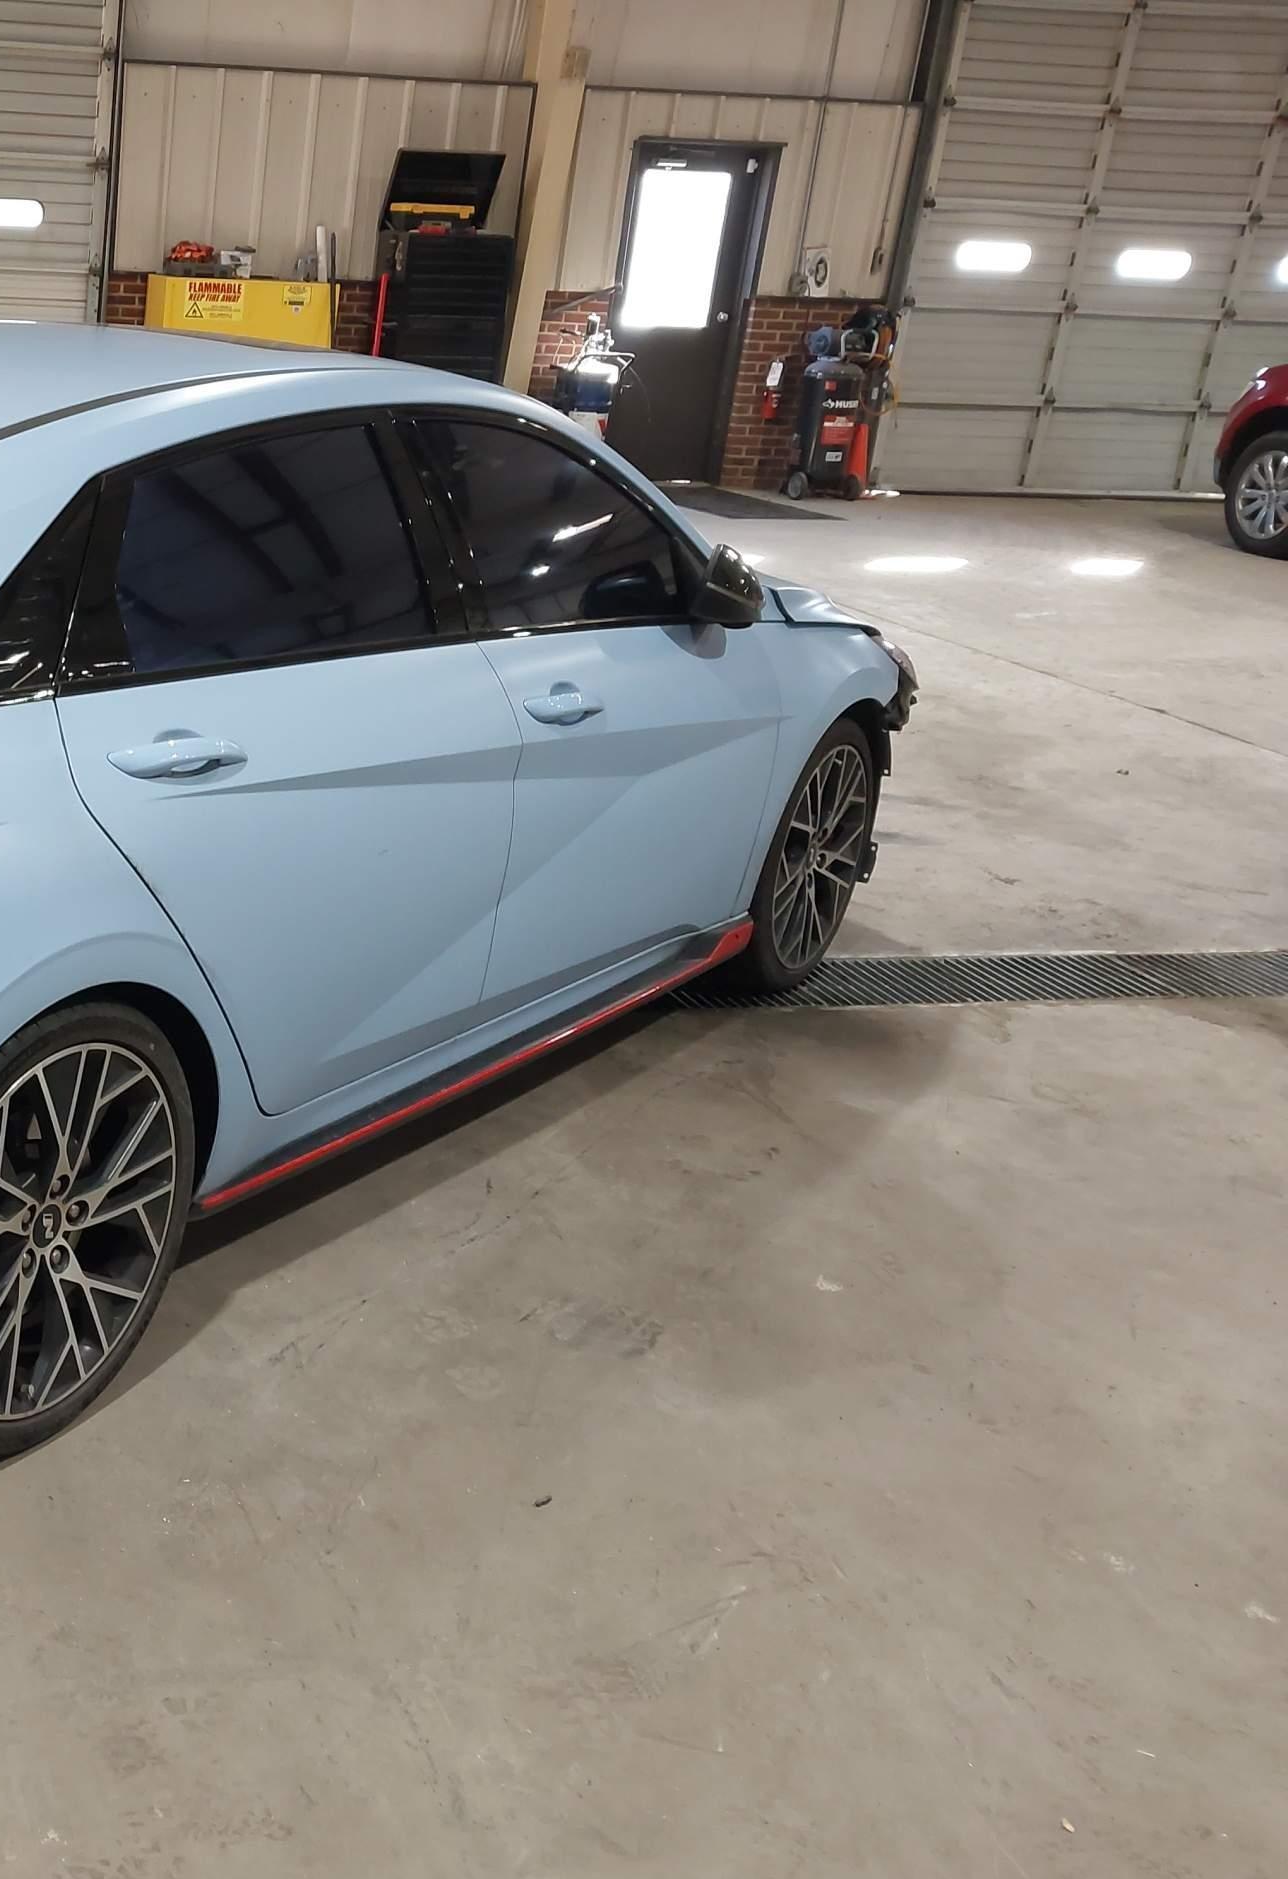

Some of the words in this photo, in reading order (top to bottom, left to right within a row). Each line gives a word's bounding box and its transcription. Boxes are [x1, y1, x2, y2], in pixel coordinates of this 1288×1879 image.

[189, 282, 242, 294] FLAMMABLE
[189, 293, 205, 301] KEEP
[206, 294, 220, 302] FIRE
[220, 294, 241, 303] AWAY
